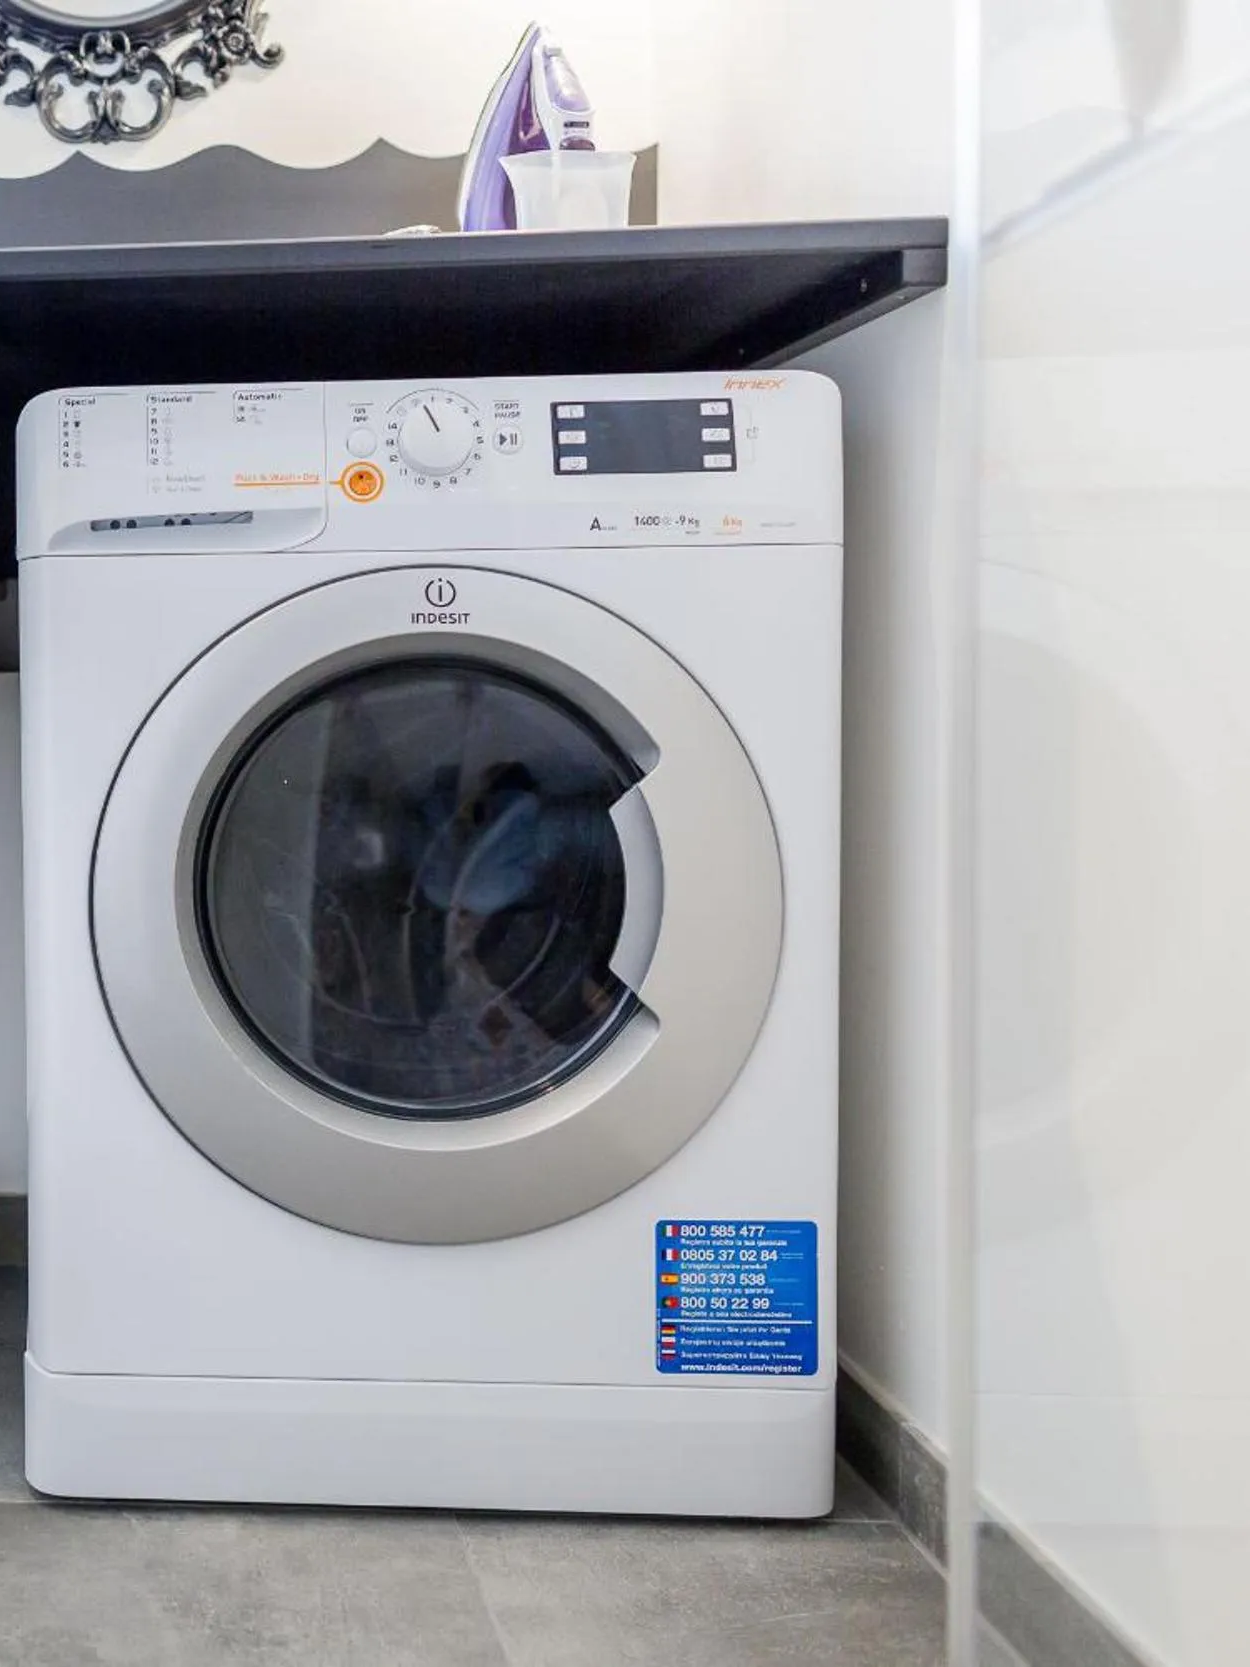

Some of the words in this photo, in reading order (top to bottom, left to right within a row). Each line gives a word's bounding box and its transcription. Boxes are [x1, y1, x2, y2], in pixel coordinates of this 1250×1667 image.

[680, 1224, 706, 1237] 800
[710, 1224, 736, 1237] 585
[739, 1225, 766, 1237] 477
[680, 1249, 715, 1261] 0805
[718, 1249, 735, 1261] 37
[739, 1249, 758, 1261] 02
[760, 1249, 778, 1261] 84
[680, 1273, 706, 1285] 900
[710, 1273, 736, 1285] 373
[739, 1273, 766, 1285] 538
[680, 1296, 706, 1309] 800
[710, 1297, 727, 1309] 50
[731, 1297, 749, 1309] 22
[752, 1298, 770, 1309] 99
